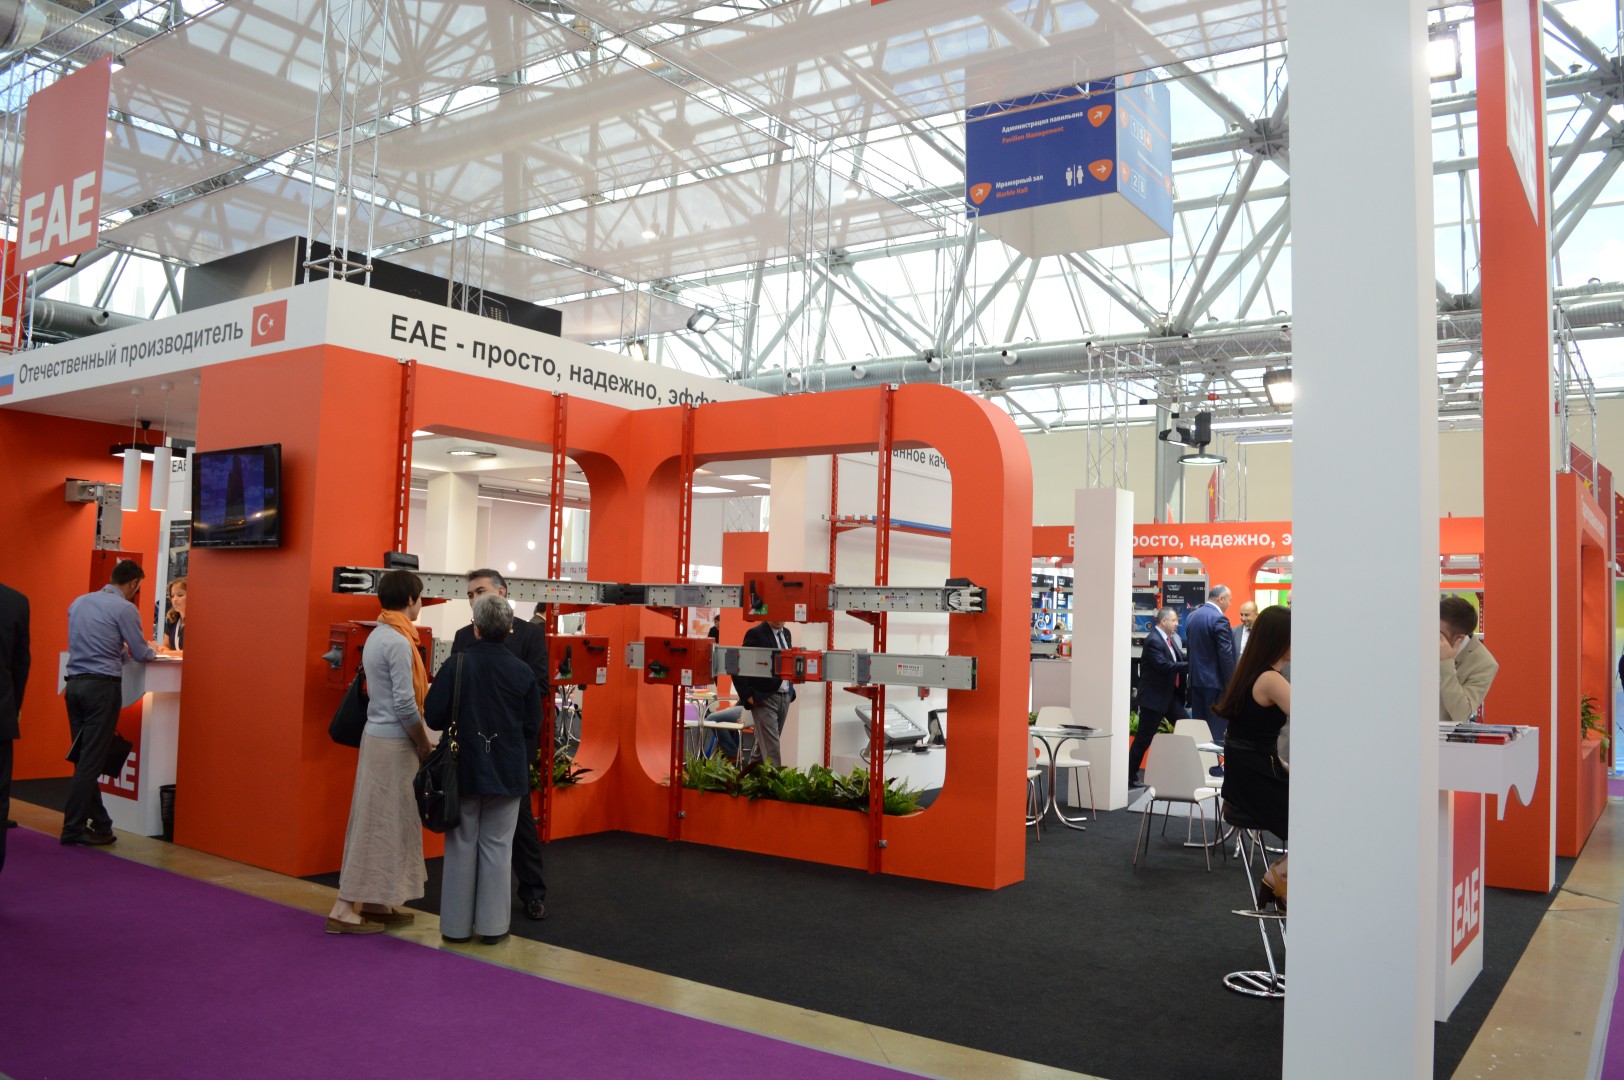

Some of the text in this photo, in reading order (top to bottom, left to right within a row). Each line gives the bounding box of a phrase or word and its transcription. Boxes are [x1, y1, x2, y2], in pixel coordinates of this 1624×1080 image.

[1002, 111, 1083, 134] Администрация павильона
[1002, 126, 1064, 144] Pavilion Management
[996, 175, 1032, 189] Мраморный
[996, 189, 1015, 198] Marble
[21, 171, 96, 260] EAE
[19, 321, 244, 384] Отечественный производитель
[391, 314, 447, 351] EAE
[473, 340, 561, 382] просто,
[570, 364, 662, 406] надежно,
[1190, 533, 1275, 549] надежно,
[1454, 868, 1479, 948] EAE
